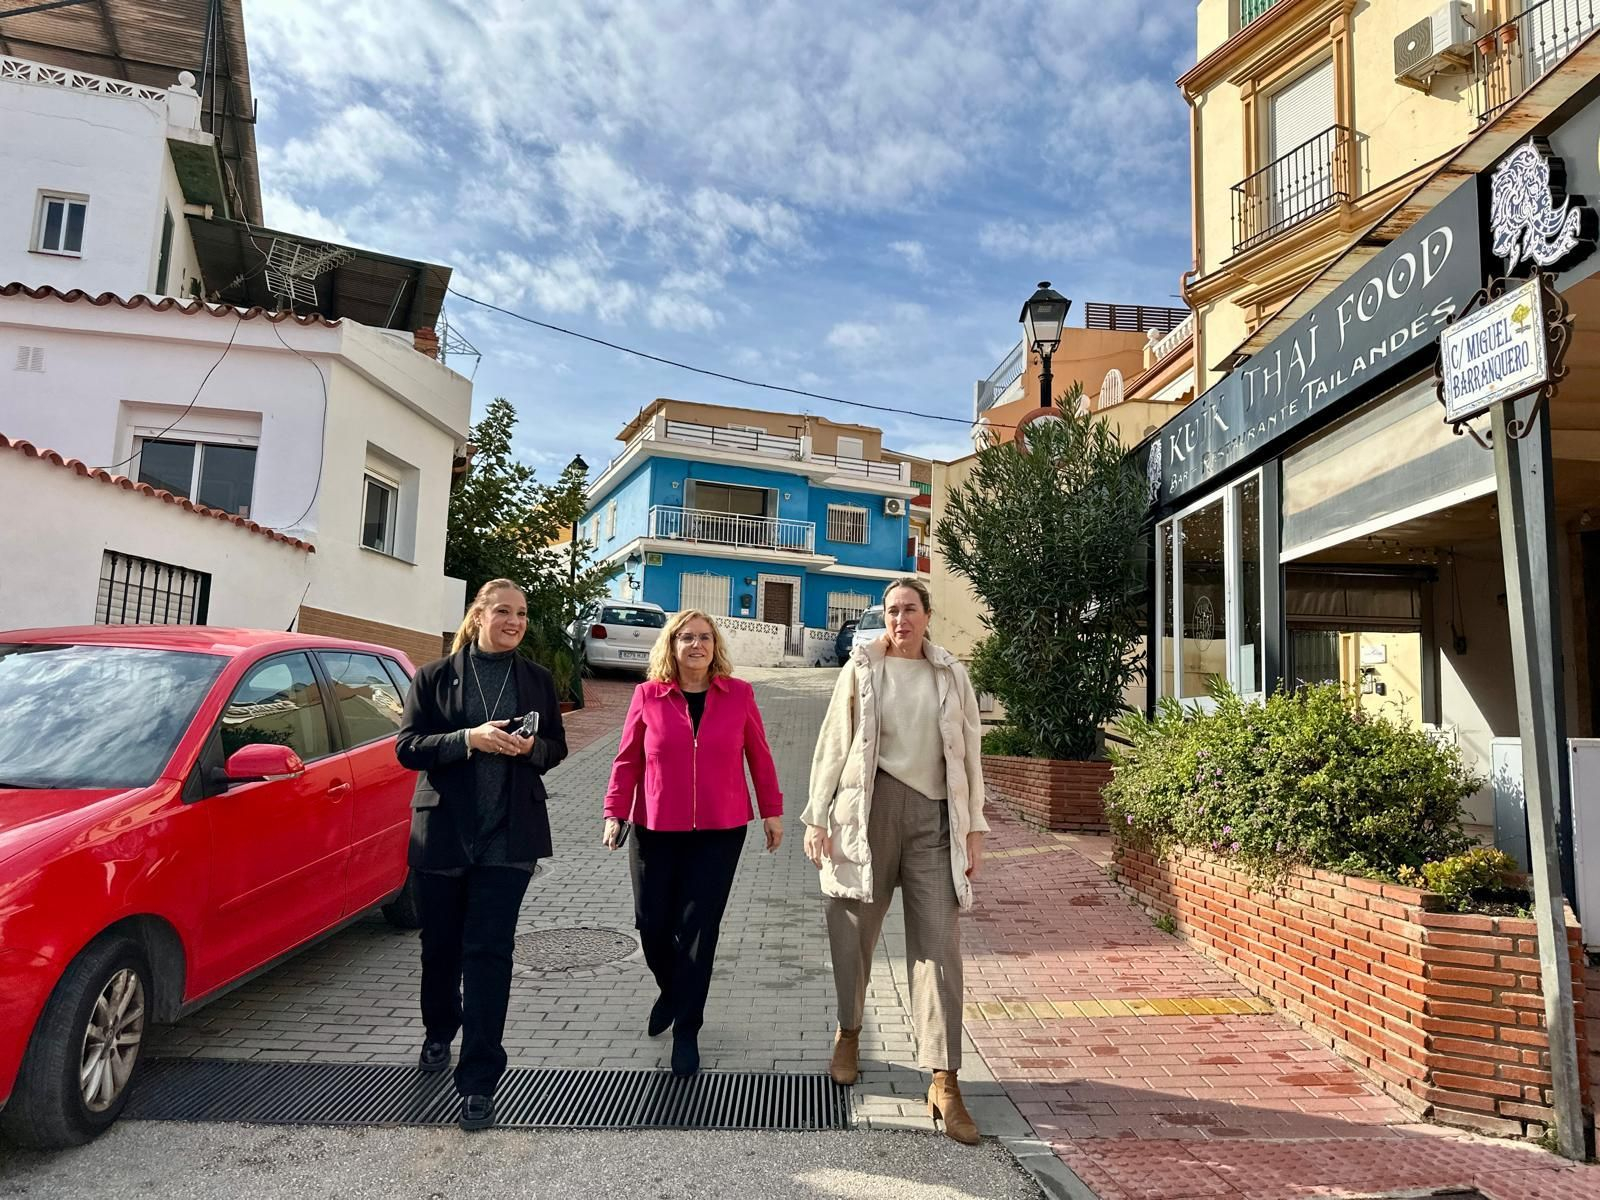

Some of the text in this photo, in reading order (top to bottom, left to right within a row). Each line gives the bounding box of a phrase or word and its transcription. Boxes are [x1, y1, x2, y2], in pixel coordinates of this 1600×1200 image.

[1336, 226, 1453, 352] FOOD
[1300, 296, 1456, 412] TAILANDÉS
[1451, 318, 1513, 370] C/ MIGUEL
[1453, 340, 1530, 399] BARRANQUERO
